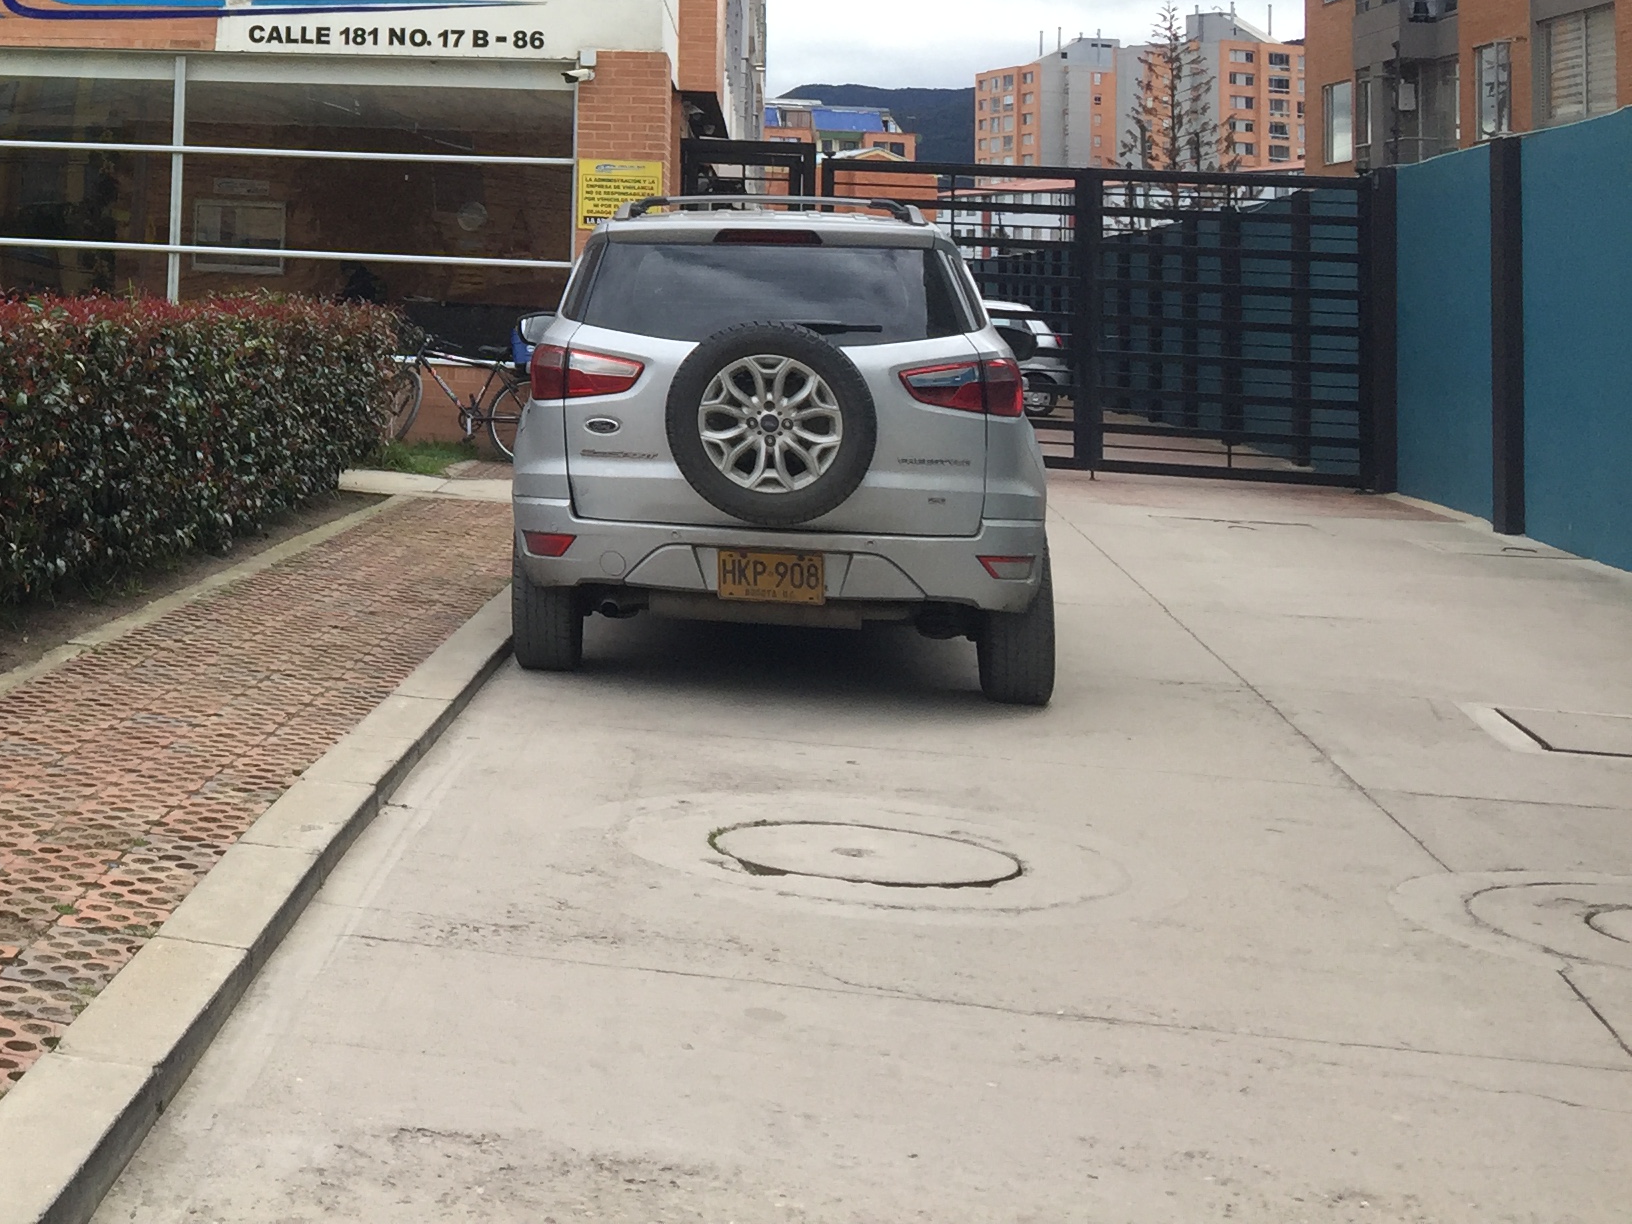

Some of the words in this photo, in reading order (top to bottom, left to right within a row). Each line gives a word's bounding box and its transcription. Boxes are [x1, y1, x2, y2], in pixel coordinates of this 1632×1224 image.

[248, 25, 331, 45] CALLE
[339, 27, 379, 46] 181
[388, 28, 432, 47] NO.
[437, 29, 465, 48] 17
[472, 30, 489, 49] B
[513, 31, 545, 50] 86
